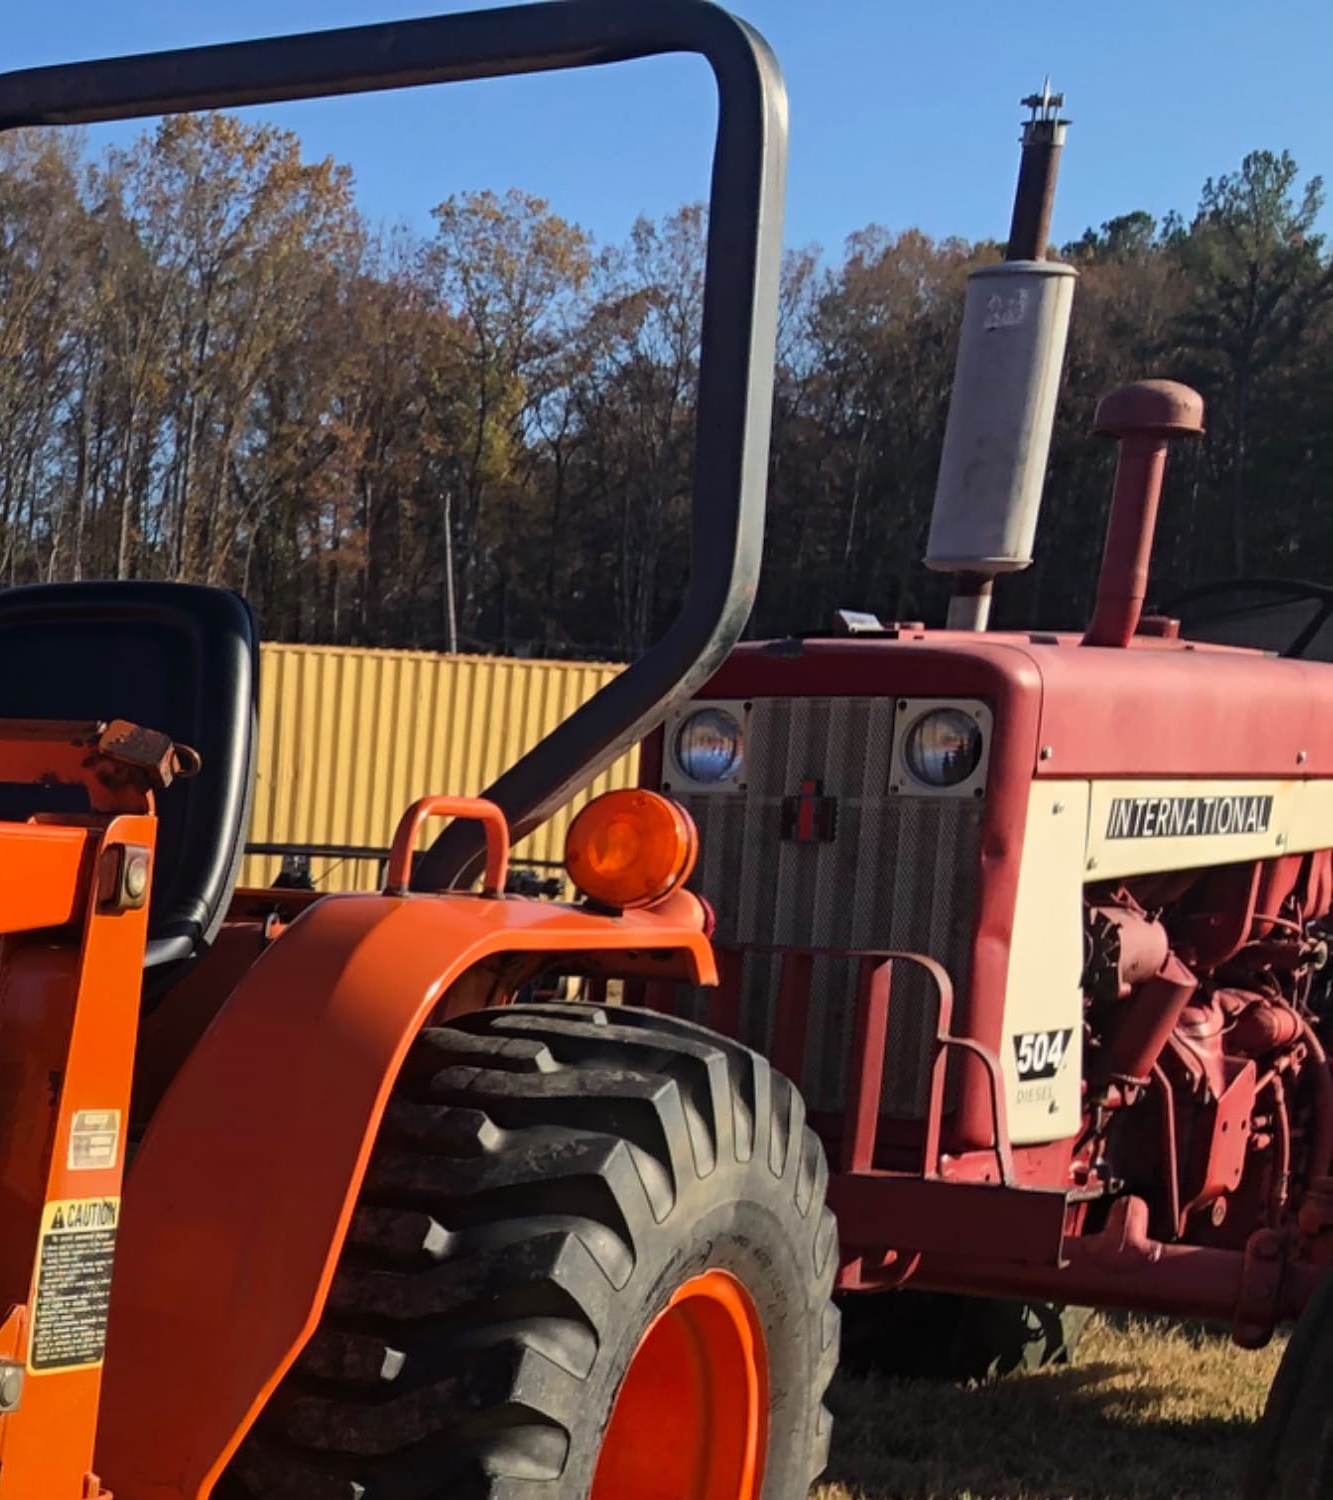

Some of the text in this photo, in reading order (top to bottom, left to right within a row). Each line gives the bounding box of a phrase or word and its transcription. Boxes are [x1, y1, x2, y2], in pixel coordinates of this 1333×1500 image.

[1107, 797, 1267, 837] INTERNATIONAL
[1017, 1030, 1064, 1074] 504
[1017, 1086, 1053, 1104] DIESEL
[67, 1201, 117, 1228] CAUTION
